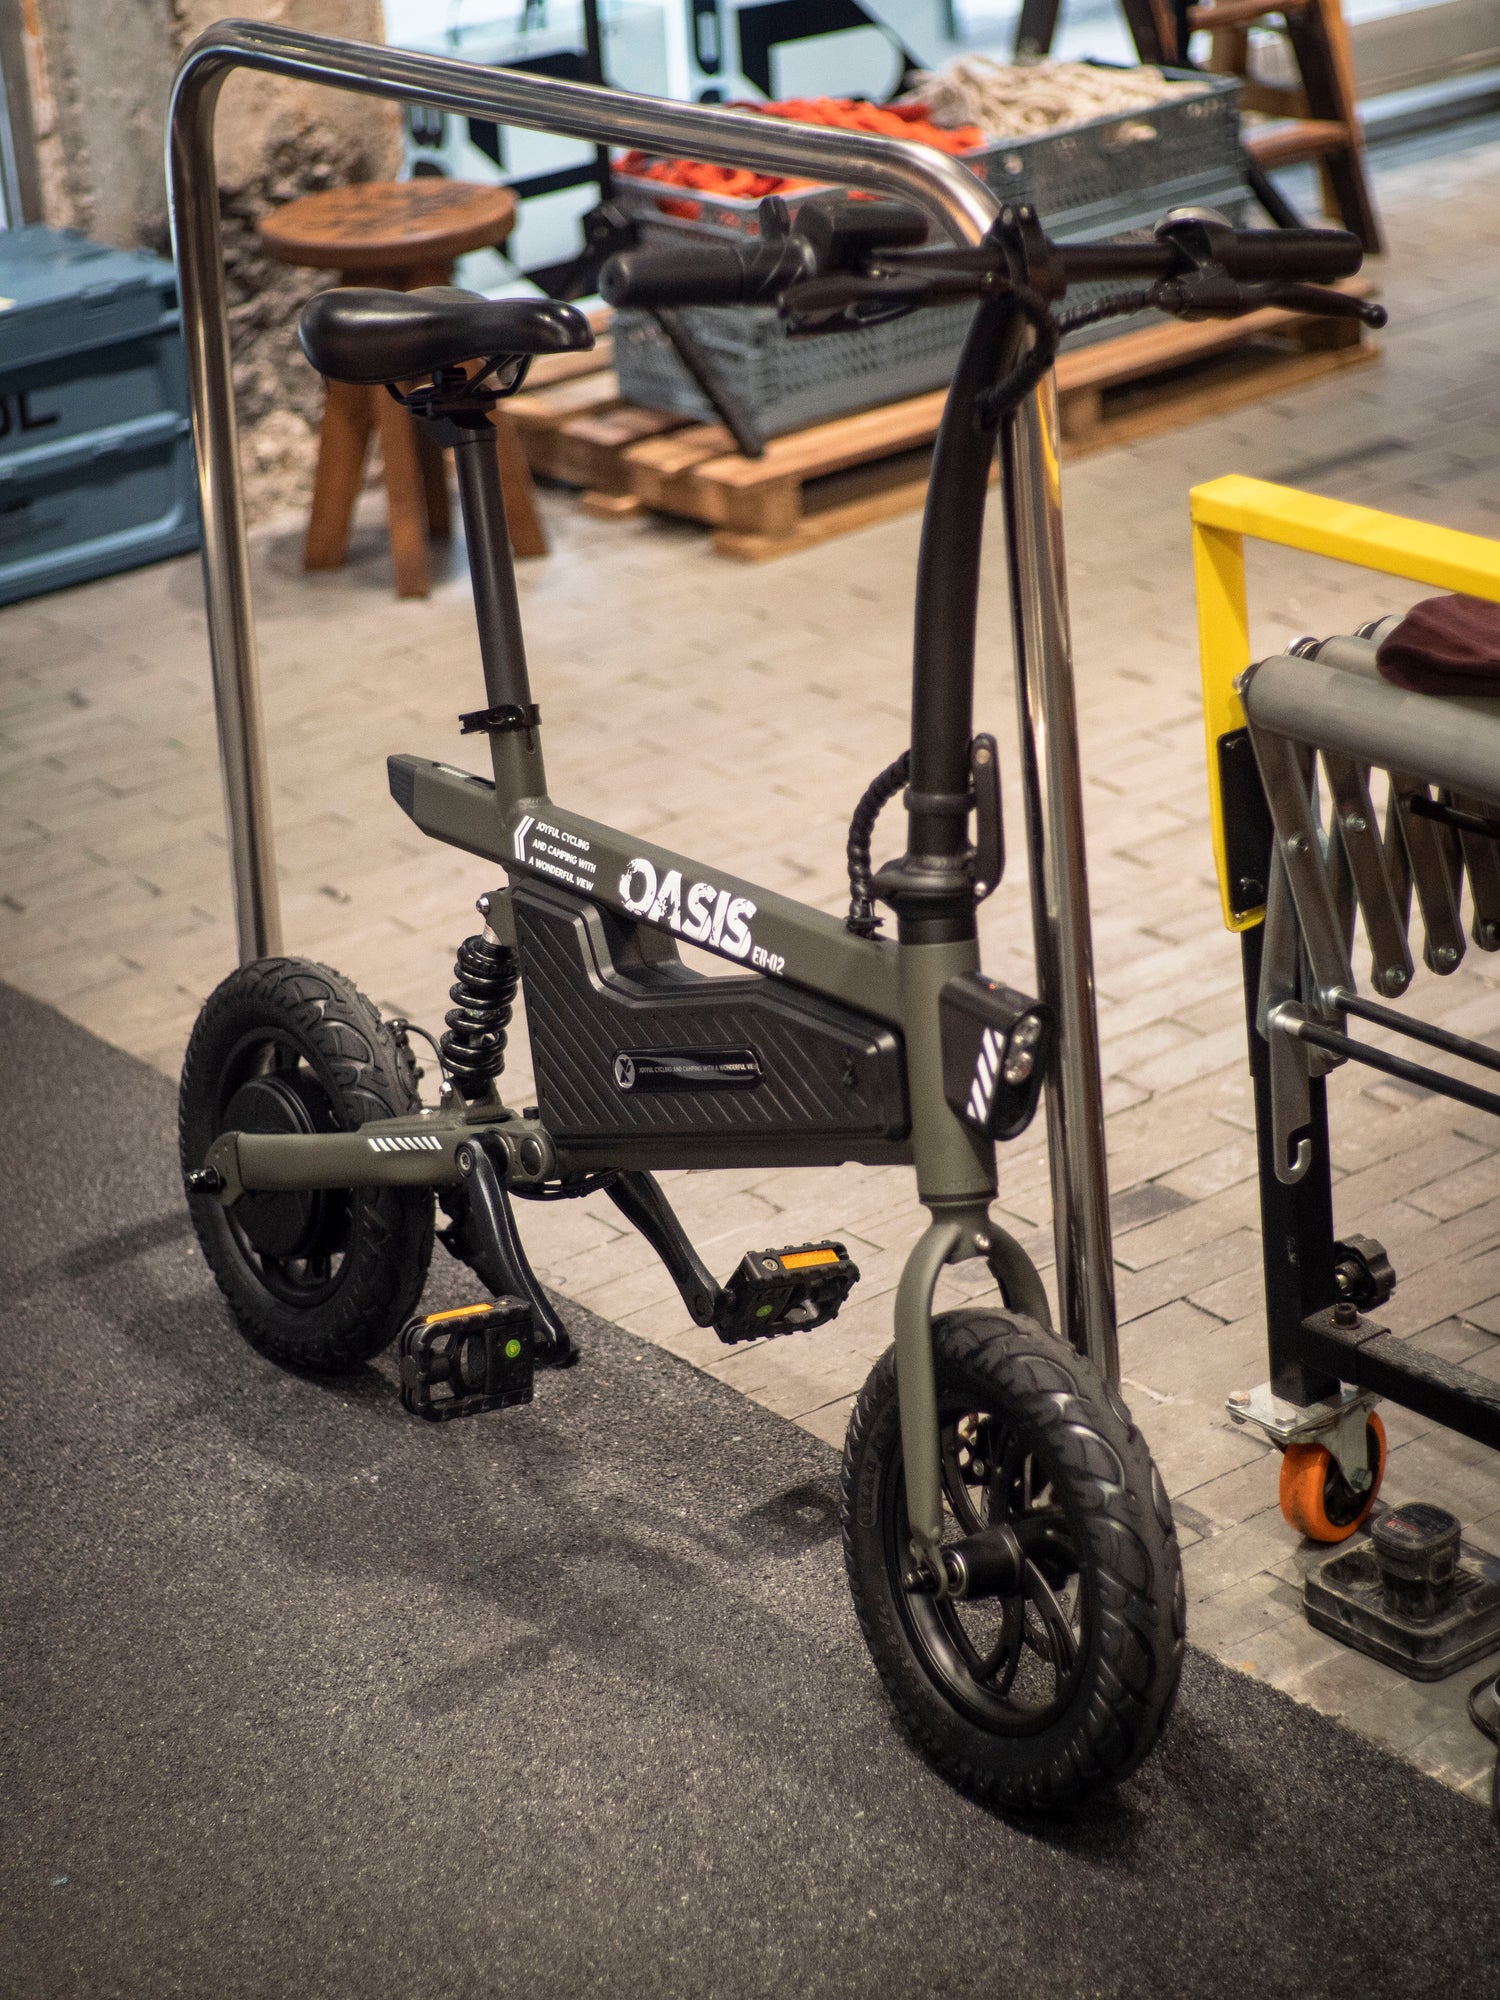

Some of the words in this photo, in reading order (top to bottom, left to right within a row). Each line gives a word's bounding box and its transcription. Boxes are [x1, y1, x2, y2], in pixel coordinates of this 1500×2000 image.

[535, 821, 560, 839] JOYFUL
[561, 832, 590, 851] CYCLING
[528, 856, 534, 866] A
[535, 858, 575, 884] WONDERFUL
[576, 876, 595, 892] VIEW
[532, 839, 547, 852] AND
[547, 846, 577, 865] CAMPING
[578, 858, 597, 874] WITH
[618, 858, 758, 959] OASIS
